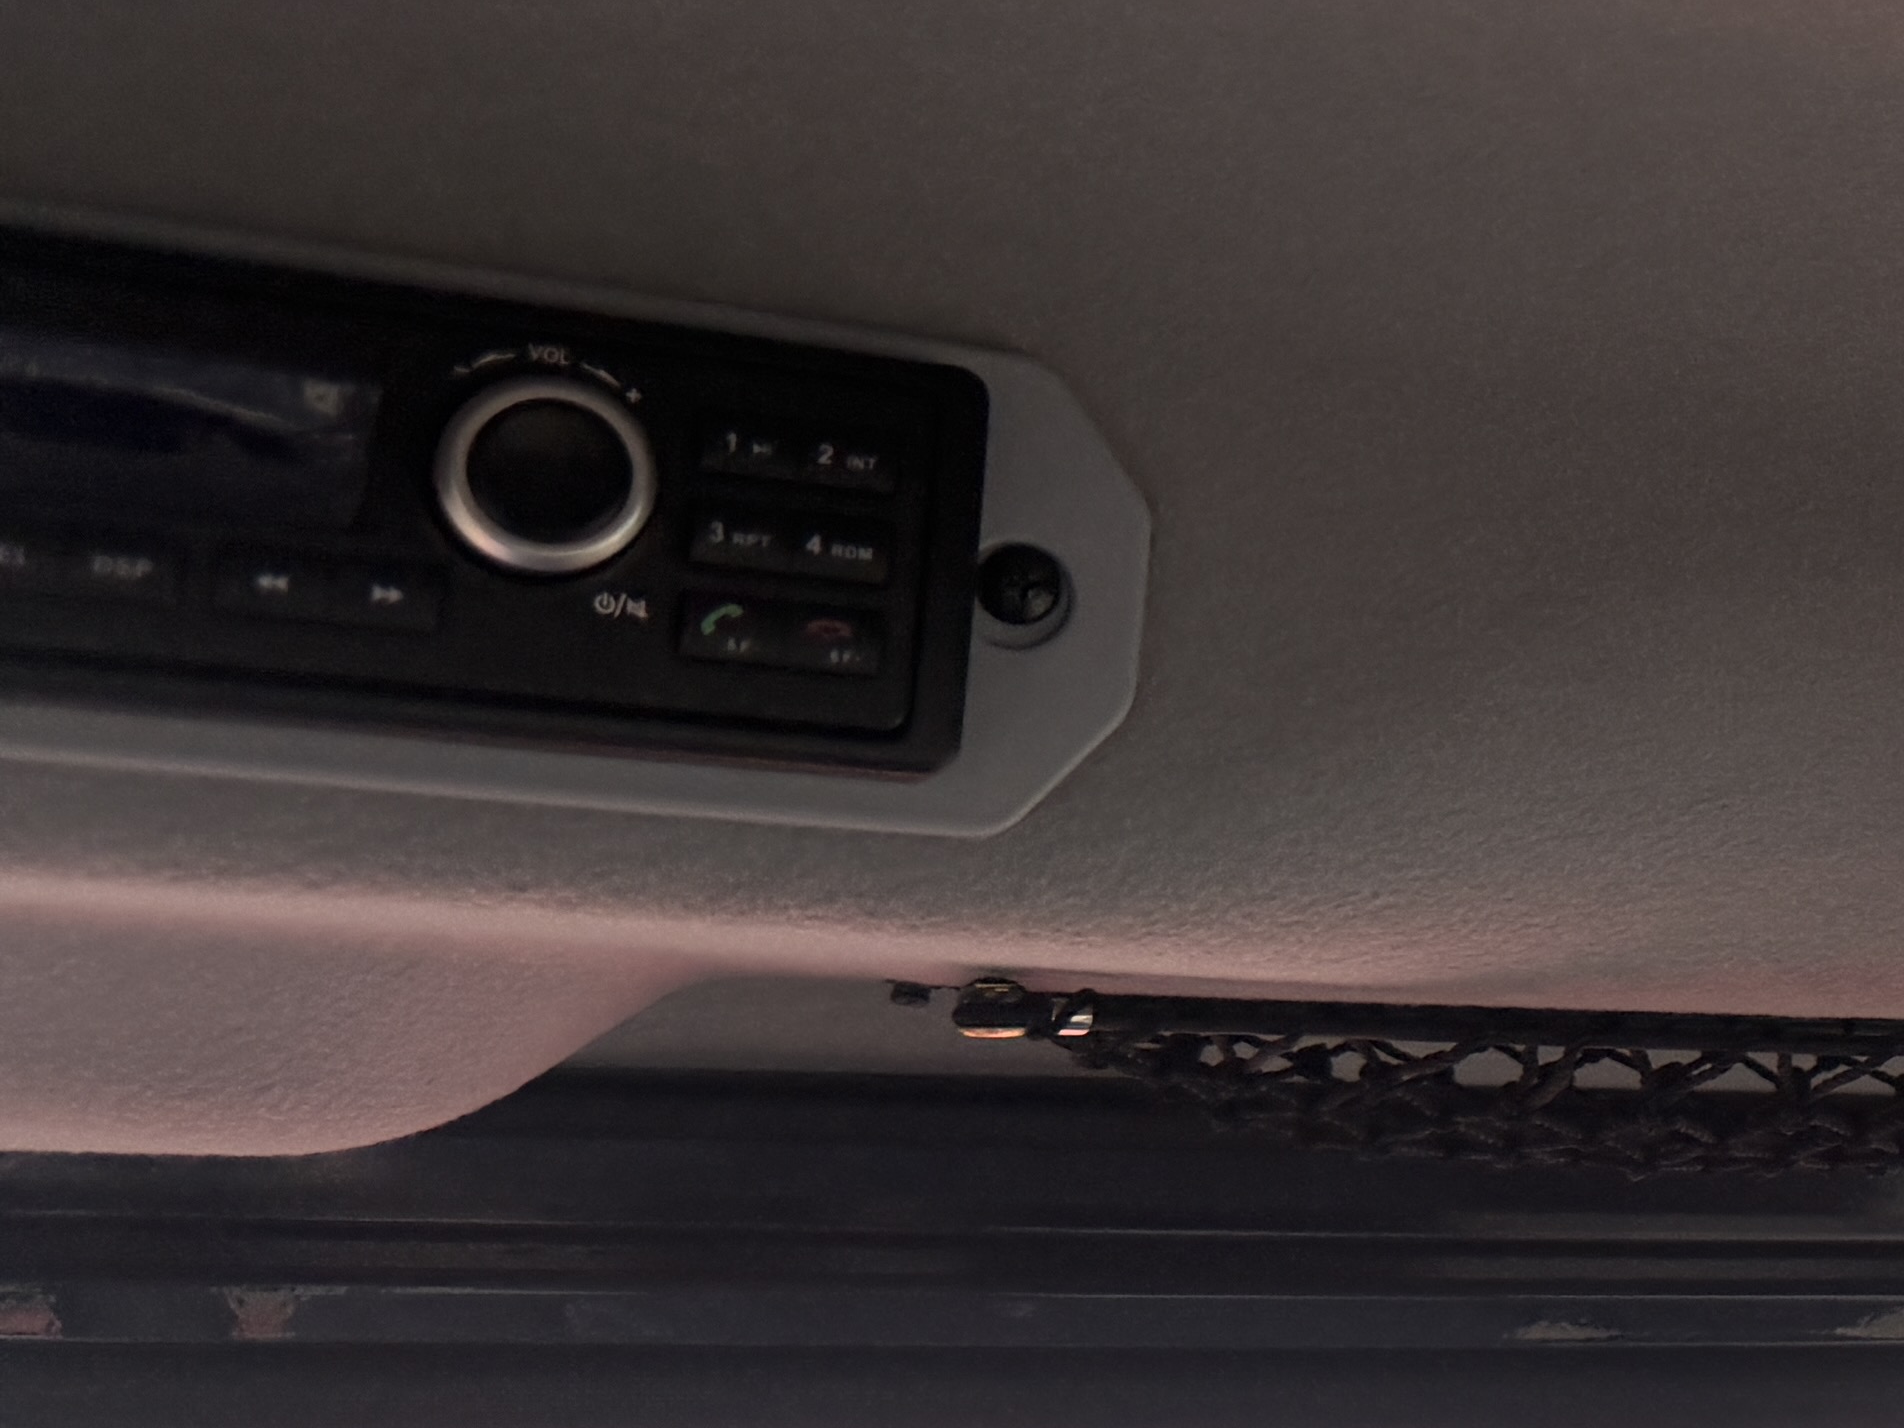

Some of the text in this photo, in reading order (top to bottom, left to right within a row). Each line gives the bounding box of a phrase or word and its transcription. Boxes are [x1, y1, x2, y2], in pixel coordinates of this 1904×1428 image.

[527, 342, 573, 366] VOL
[726, 431, 738, 454] 1
[817, 442, 879, 471] 2 INT
[708, 520, 774, 549] 3 RPT
[805, 533, 874, 561] 4 RDM
